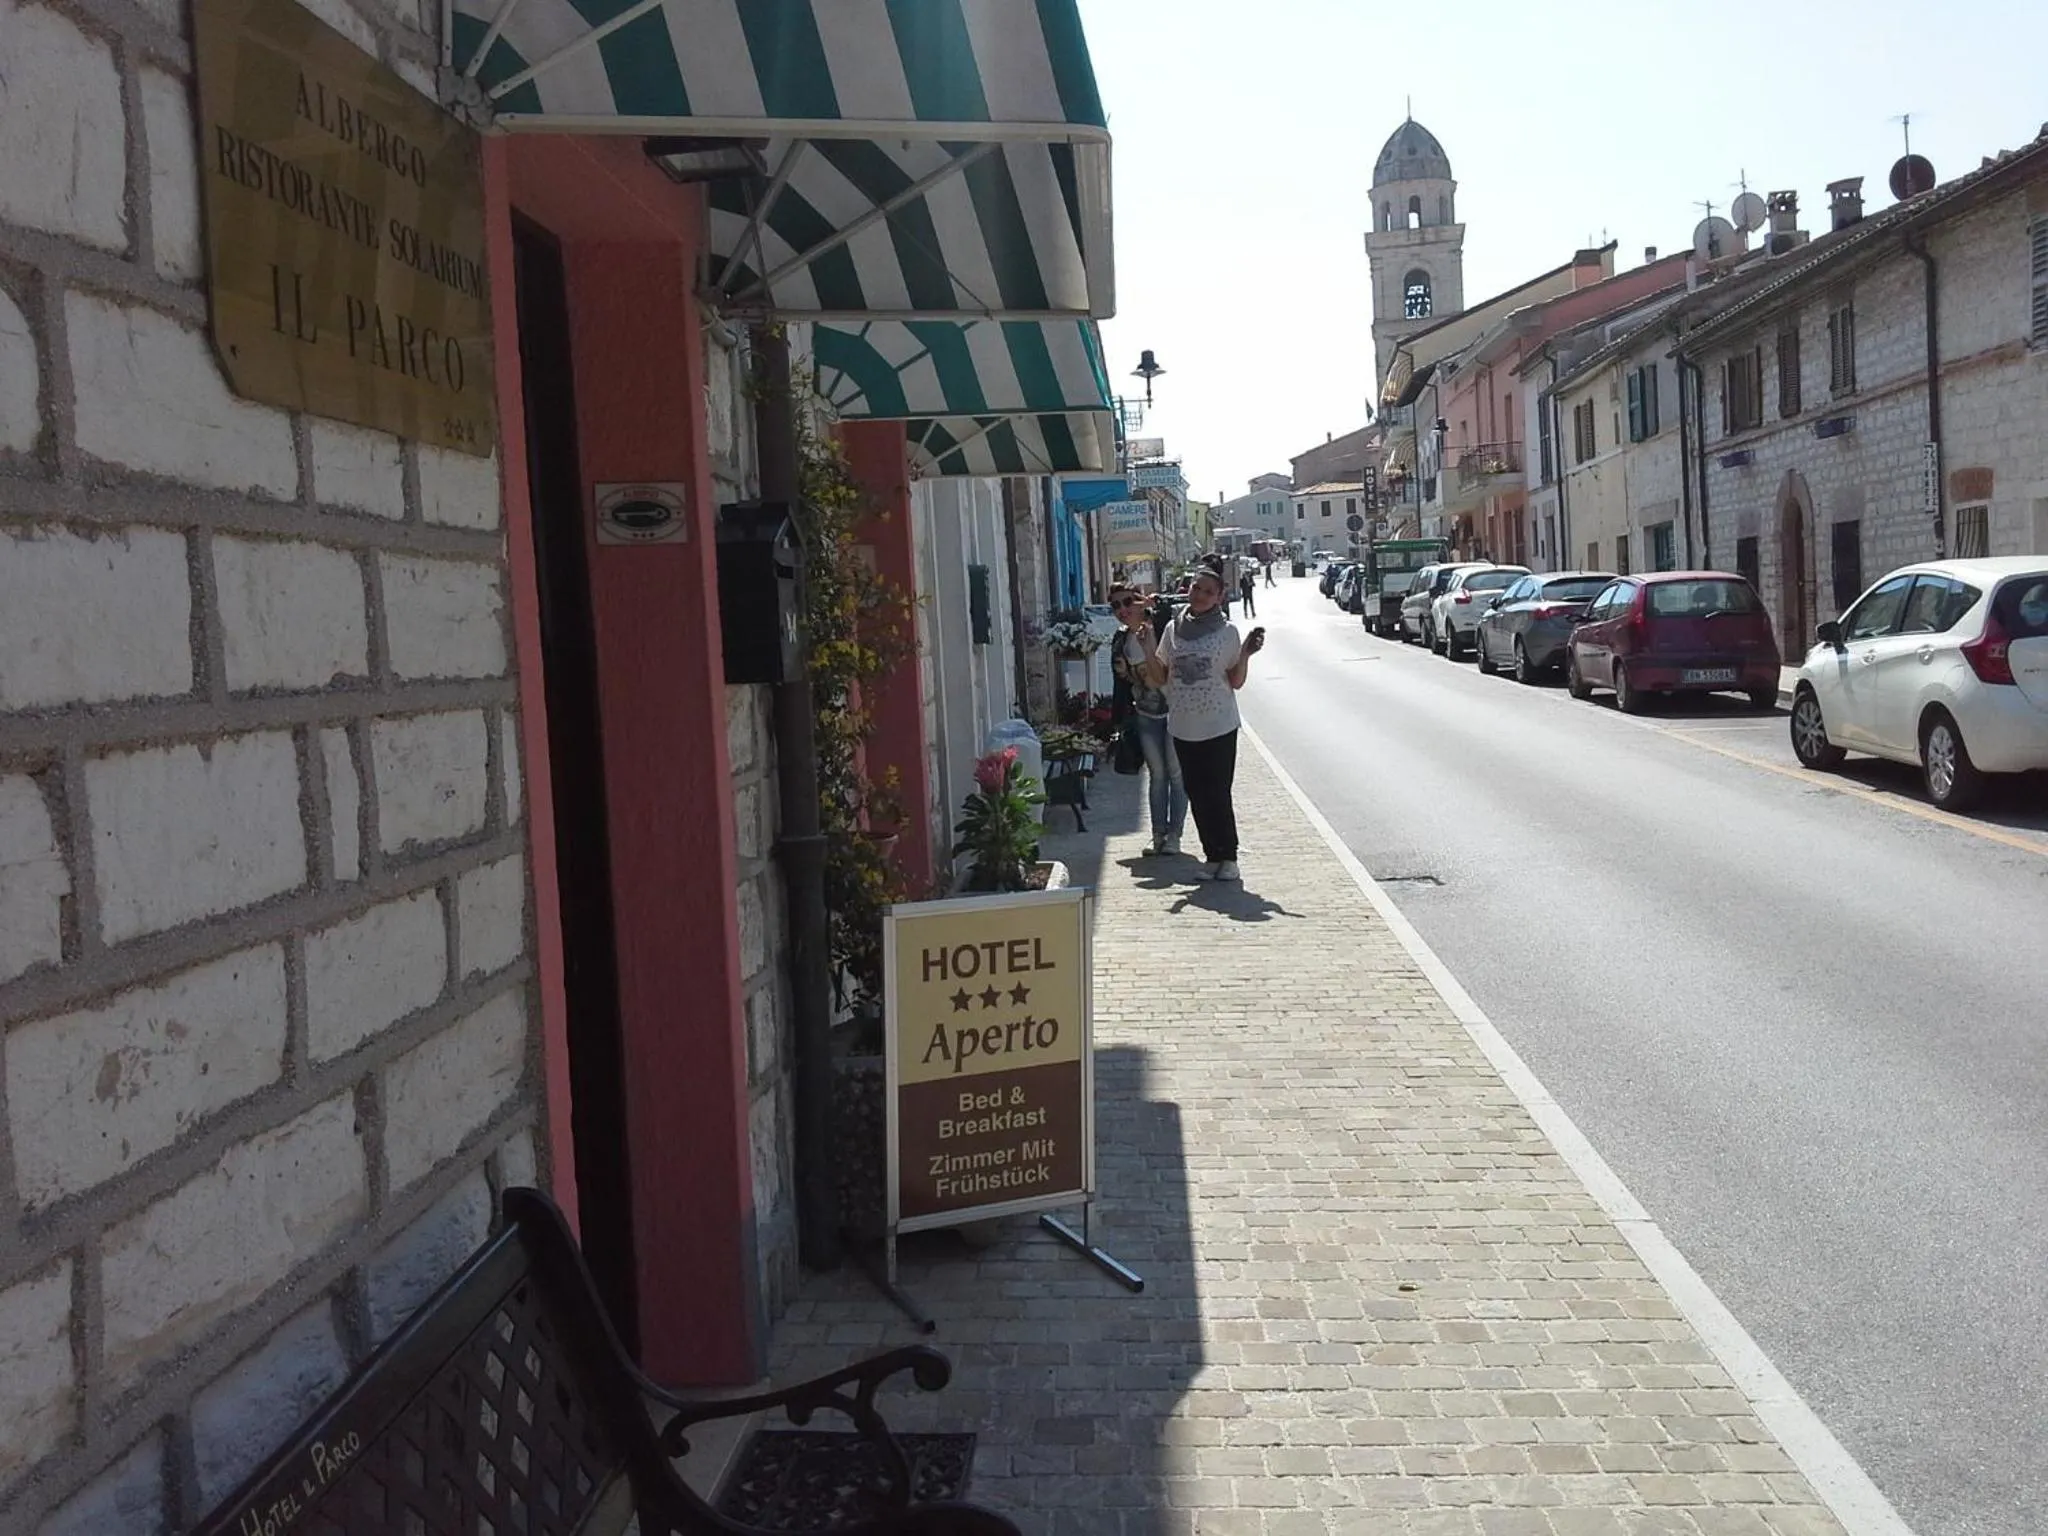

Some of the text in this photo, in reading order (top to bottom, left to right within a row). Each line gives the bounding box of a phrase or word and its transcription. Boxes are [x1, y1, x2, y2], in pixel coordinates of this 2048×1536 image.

[294, 71, 427, 188] ALBERGO
[215, 126, 483, 301] RISTORANTE SOLARIUM
[269, 263, 466, 394] IL PARCO
[1366, 469, 1375, 507] HOTEL
[921, 937, 1056, 983] HOTEL
[921, 1015, 1059, 1073] Aperto
[938, 1106, 1047, 1139] Breakfast
[959, 1086, 1026, 1113] Bed &
[929, 1138, 1056, 1176] Zimmer Mit
[935, 1163, 1051, 1198] Frühstück
[310, 1431, 360, 1485] PARCO
